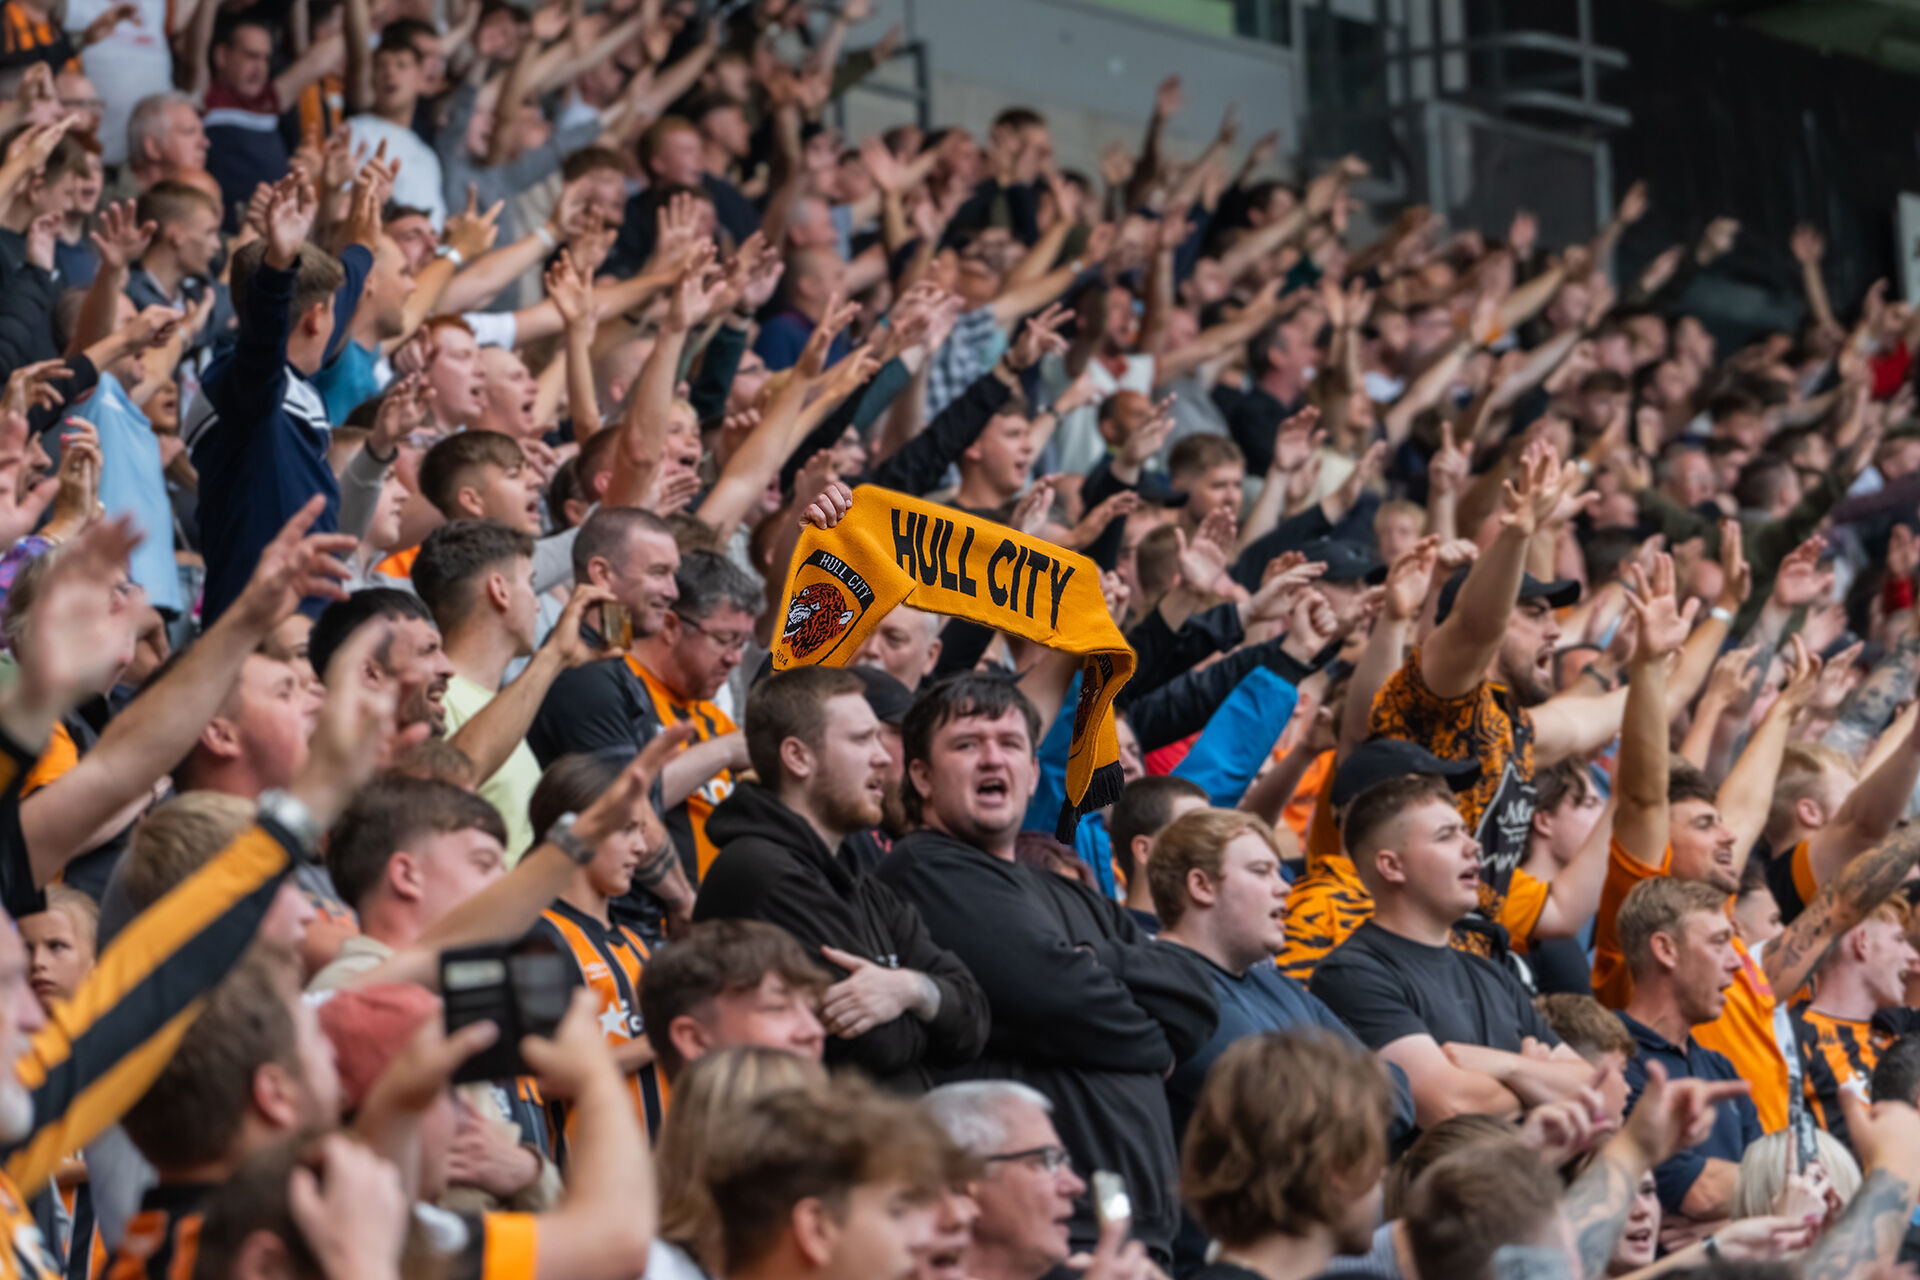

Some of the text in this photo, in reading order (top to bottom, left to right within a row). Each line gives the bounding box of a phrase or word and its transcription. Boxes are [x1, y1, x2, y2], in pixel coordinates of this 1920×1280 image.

[819, 553, 872, 600] HULL CITY
[891, 508, 1076, 630] HULL CITY
